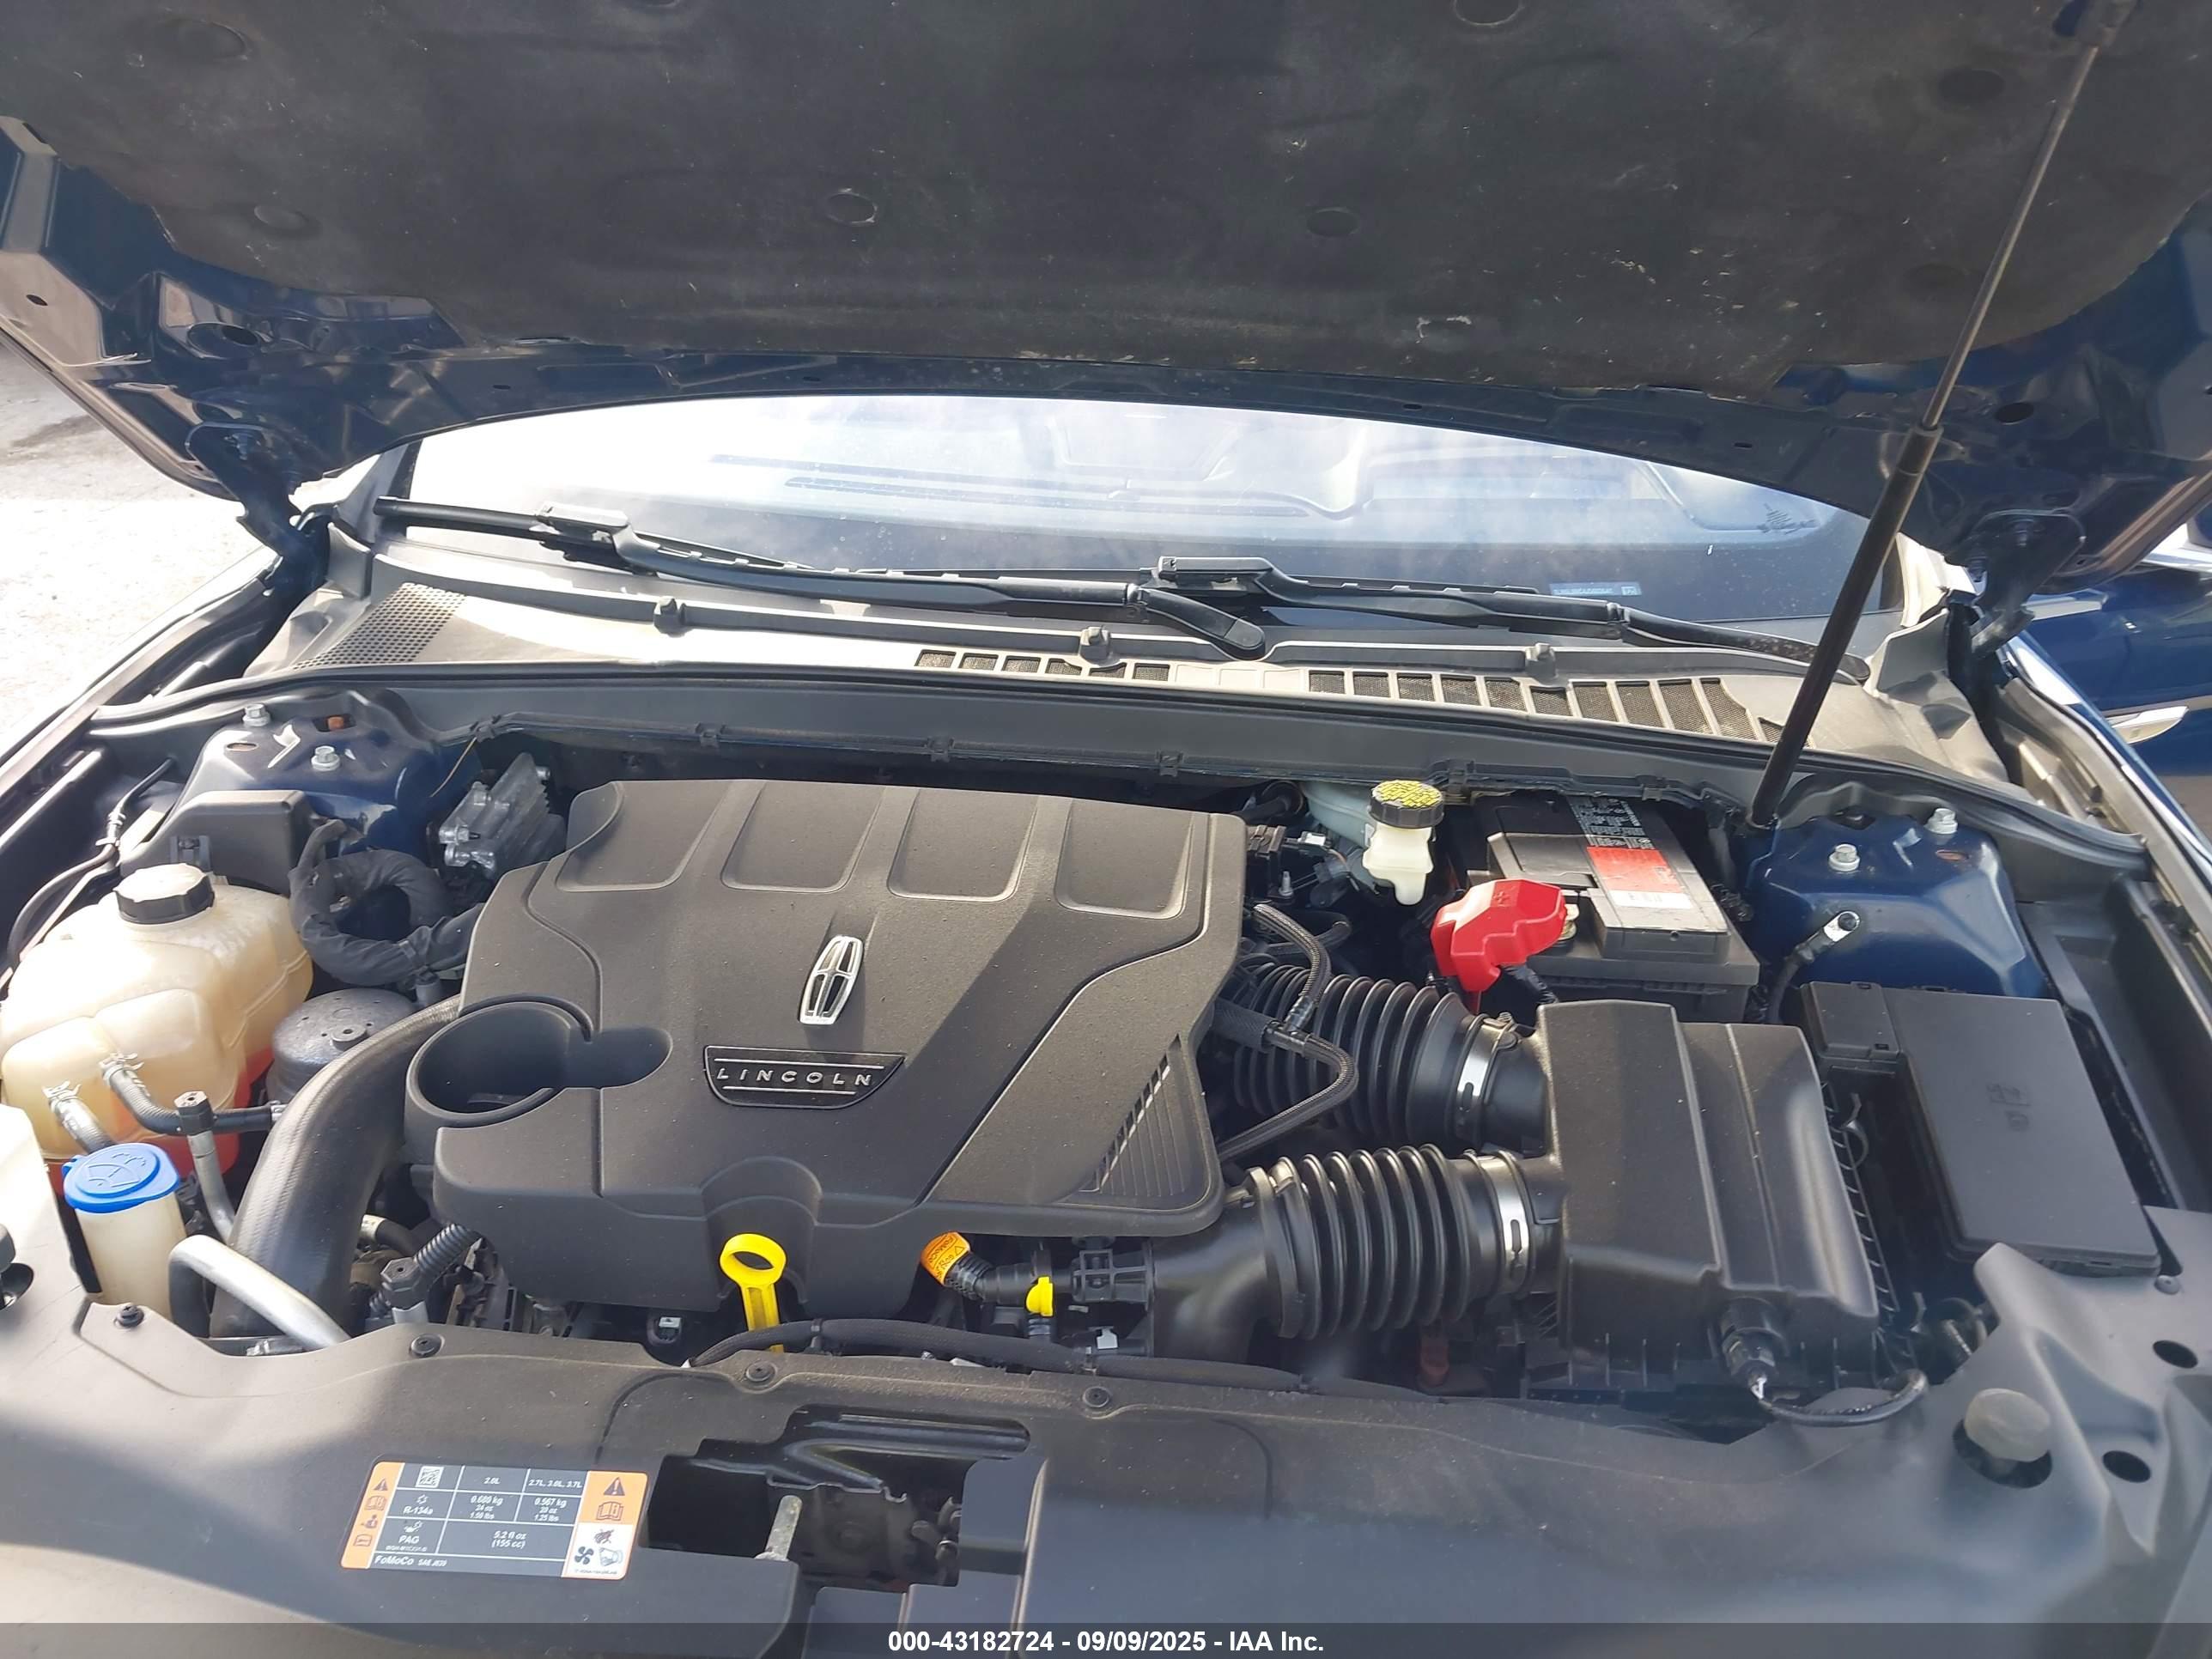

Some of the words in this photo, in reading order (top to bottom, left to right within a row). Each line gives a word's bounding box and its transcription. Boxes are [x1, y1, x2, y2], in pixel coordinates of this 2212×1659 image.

[716, 1067, 872, 1086] LINCOLN
[492, 1496, 503, 1506] kg
[556, 1498, 568, 1508] kg
[403, 1505, 434, 1515] R-134a
[398, 1534, 420, 1544] PAG
[493, 1530, 507, 1539] 5.2
[491, 1539, 511, 1548] (155
[512, 1540, 526, 1550] cc)
[374, 1555, 414, 1565] FoMoCo
